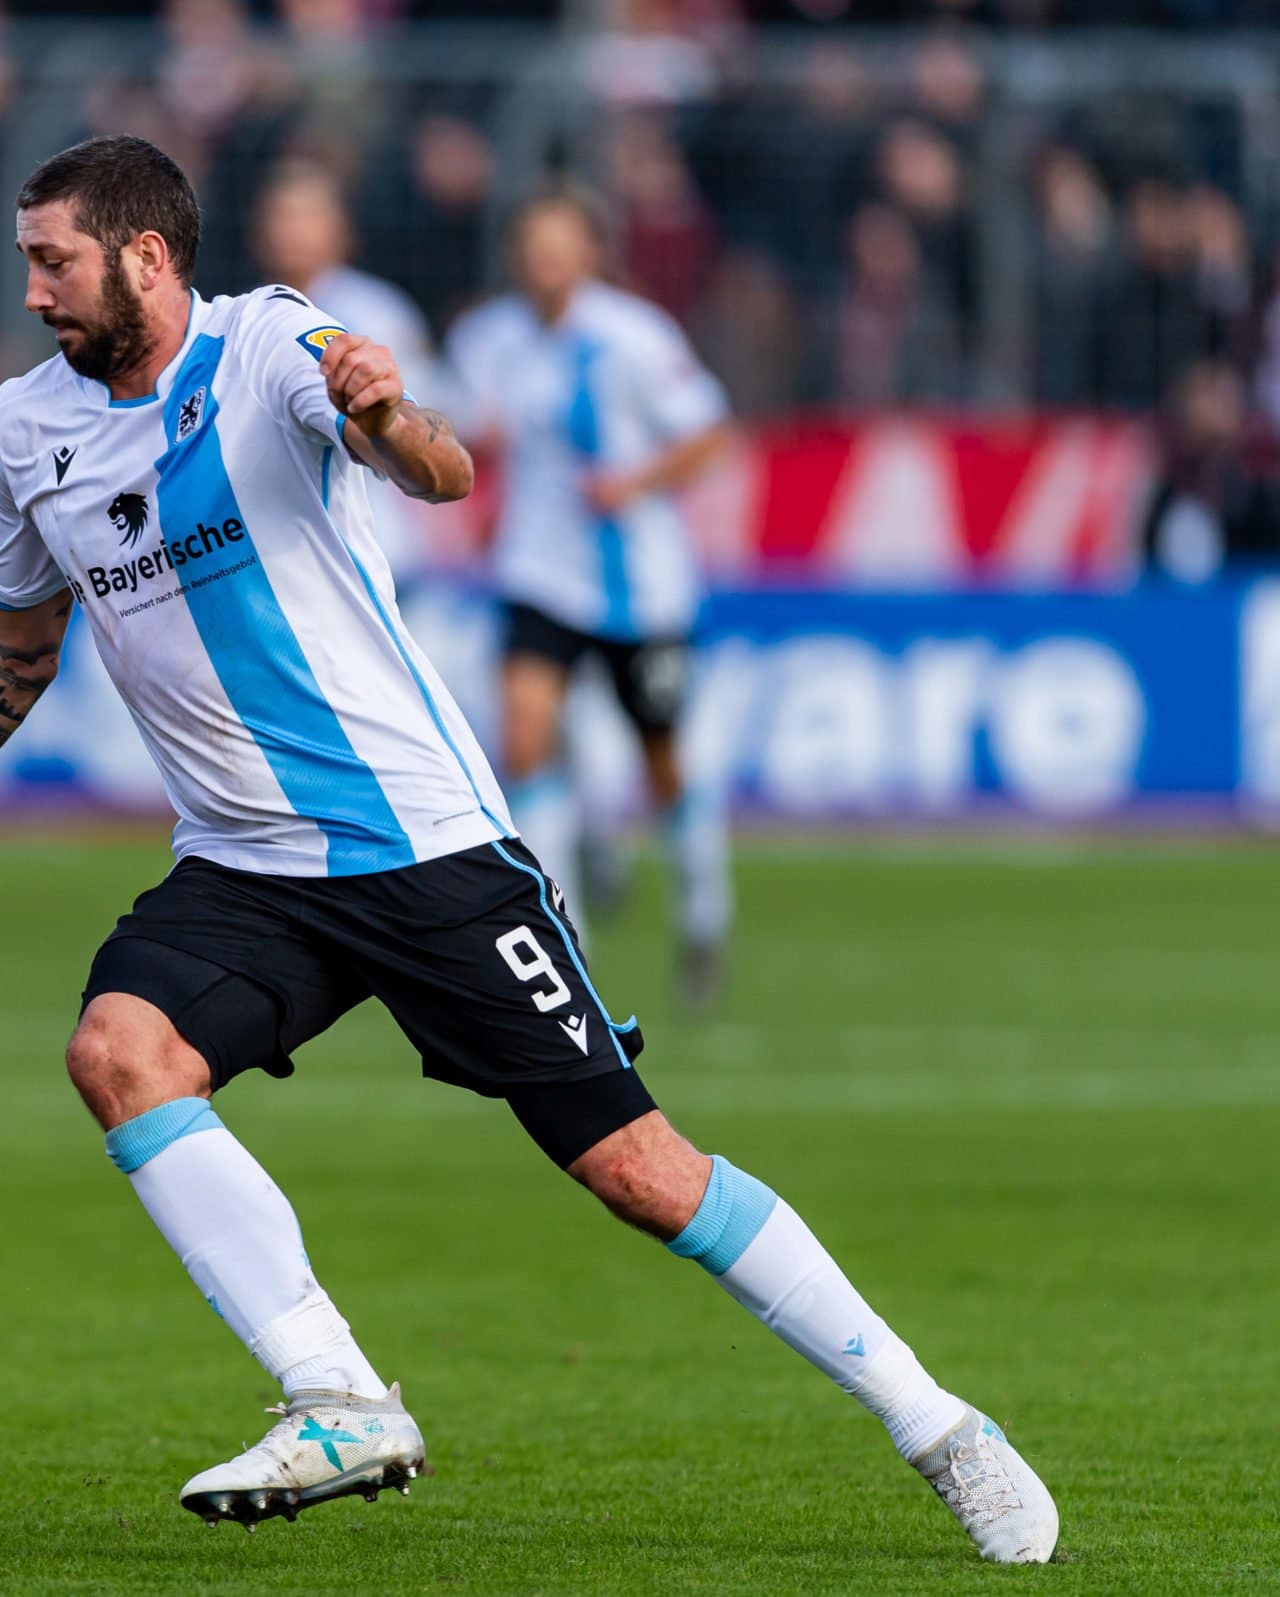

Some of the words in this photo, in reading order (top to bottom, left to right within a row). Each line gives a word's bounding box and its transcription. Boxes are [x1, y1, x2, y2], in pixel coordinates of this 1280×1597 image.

[87, 517, 245, 599] Bayerische
[120, 599, 155, 618] Versichert
[155, 591, 173, 606] nach
[496, 925, 572, 1013] 9
